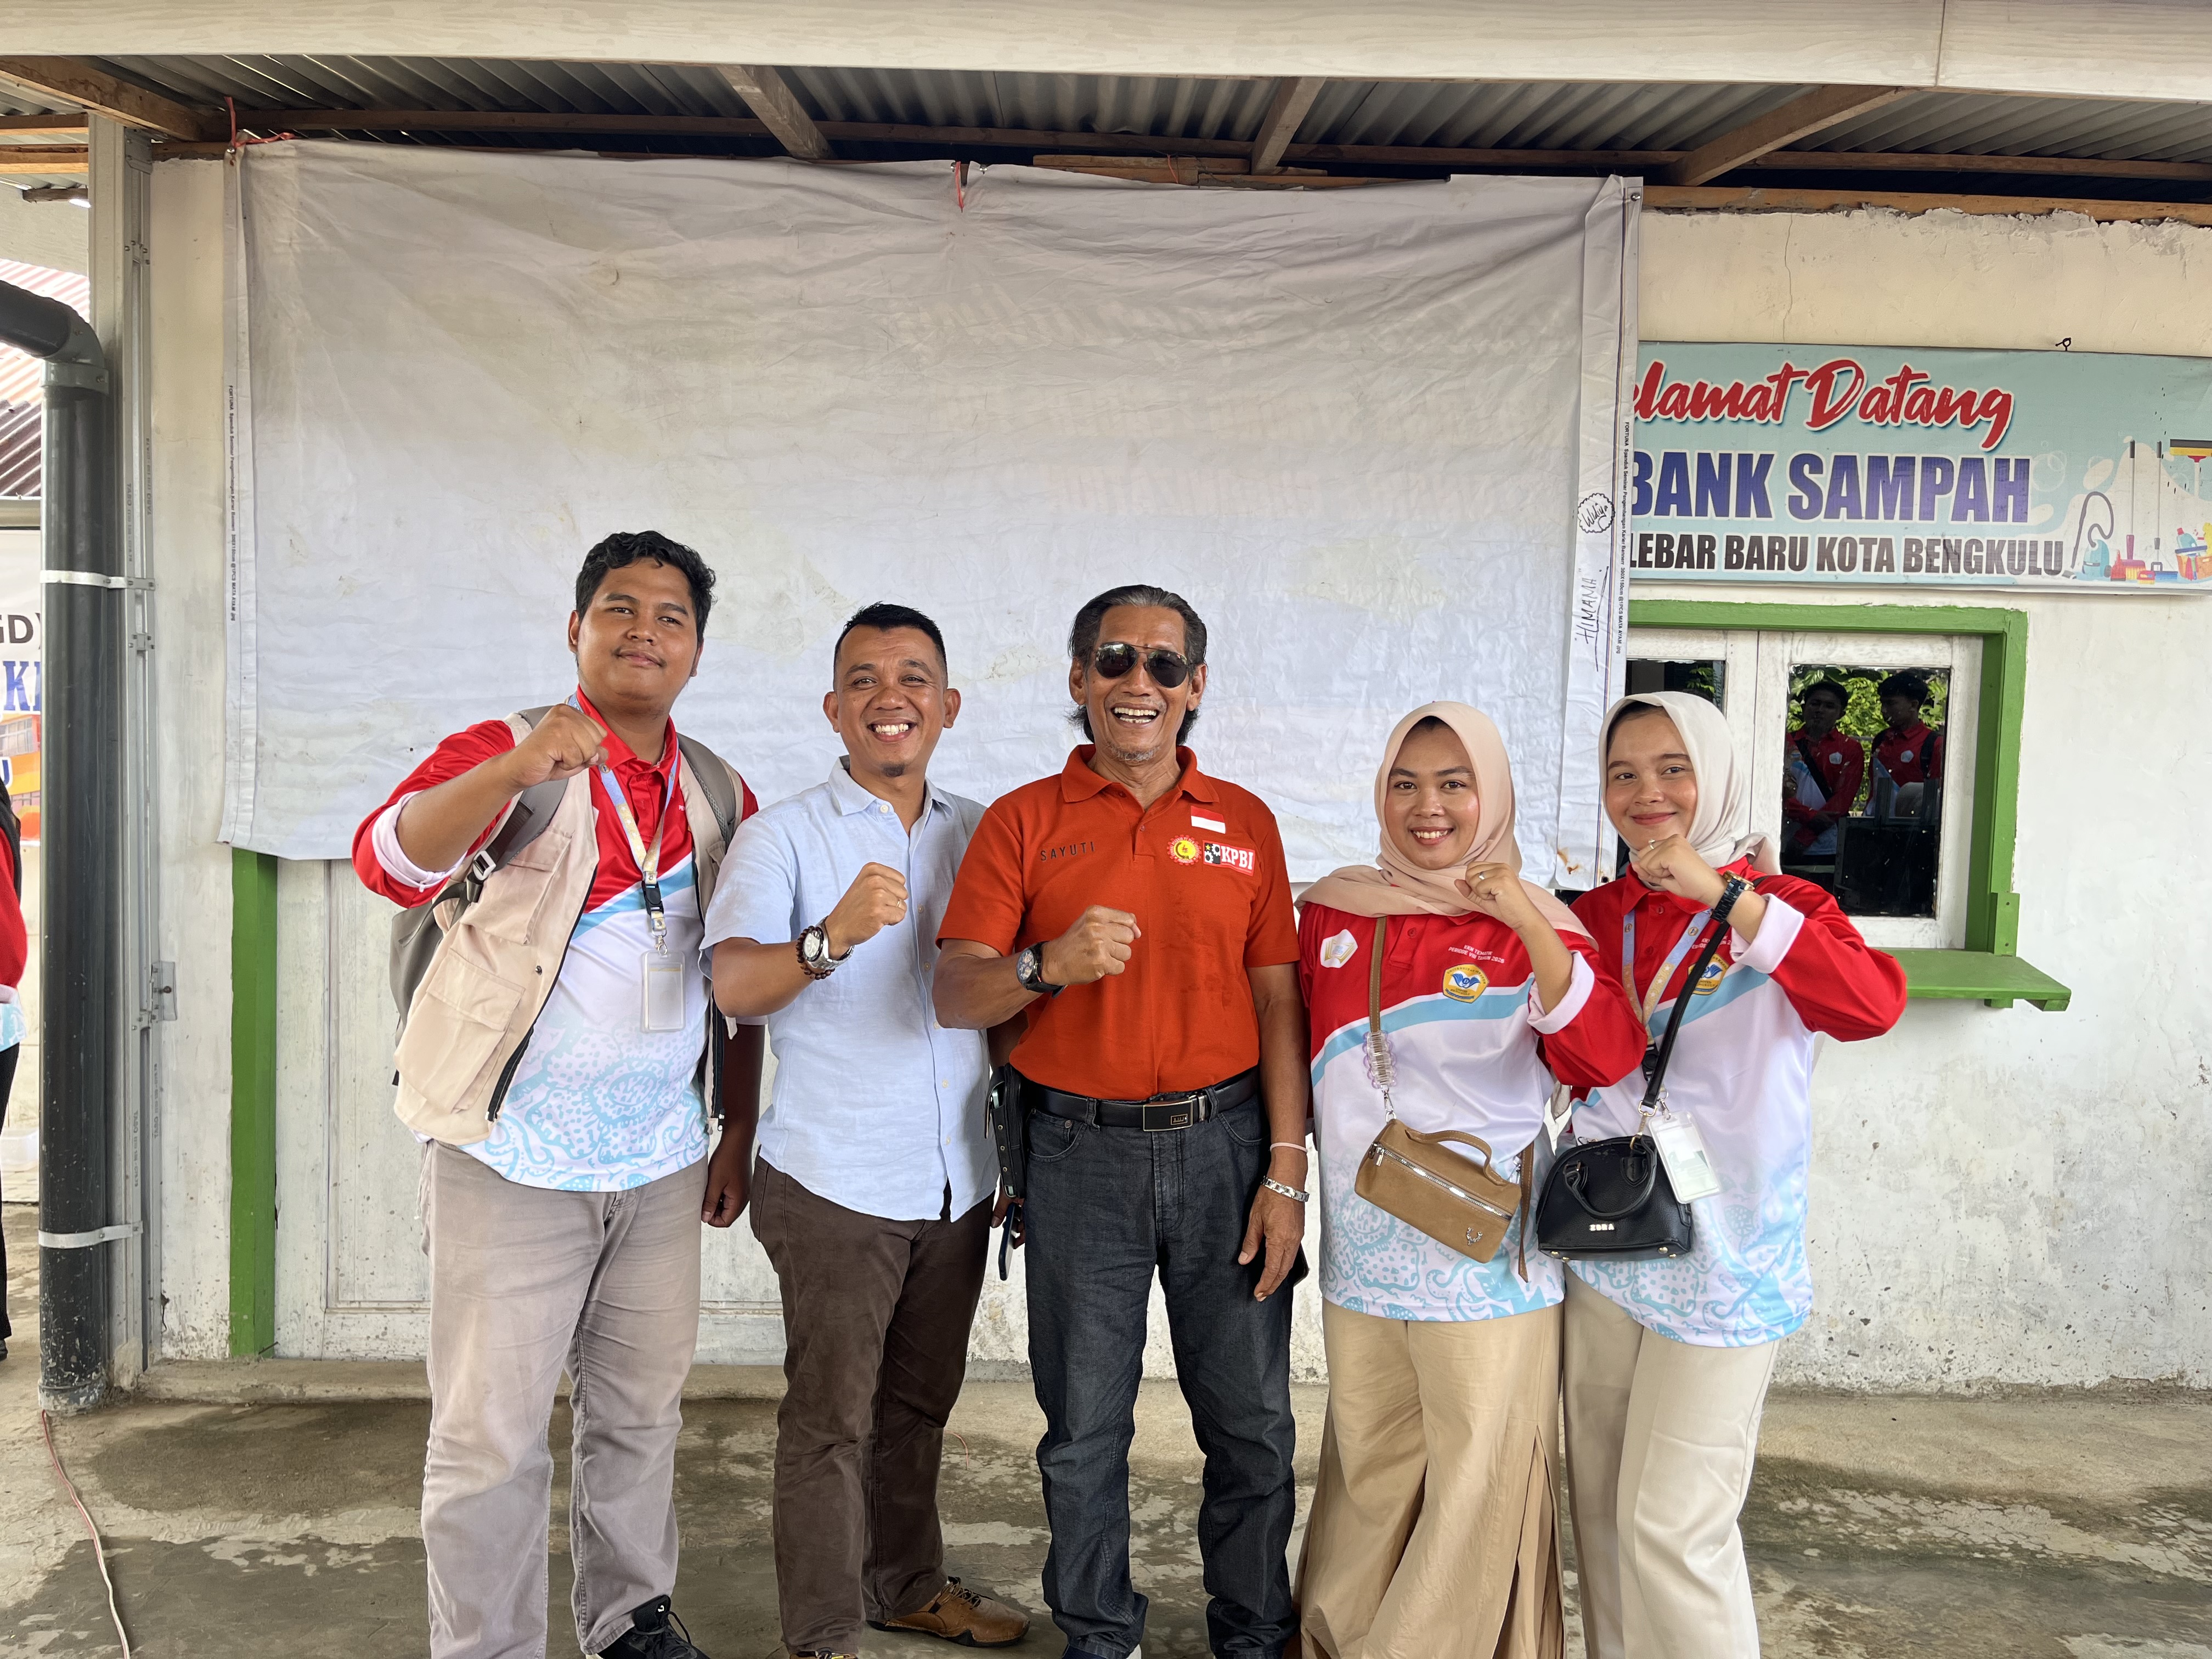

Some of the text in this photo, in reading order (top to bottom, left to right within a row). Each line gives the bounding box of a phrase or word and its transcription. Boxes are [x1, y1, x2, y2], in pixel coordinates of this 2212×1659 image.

[1804, 359, 2013, 449] Datang
[1632, 451, 2030, 523] BANK SAMPAH
[1724, 535, 1809, 572] BARU
[1816, 537, 1895, 573] KOTA
[1903, 538, 2063, 575] BENGKULU
[1041, 842, 1093, 861] SAYUTI
[1221, 846, 1254, 870] KPBI
